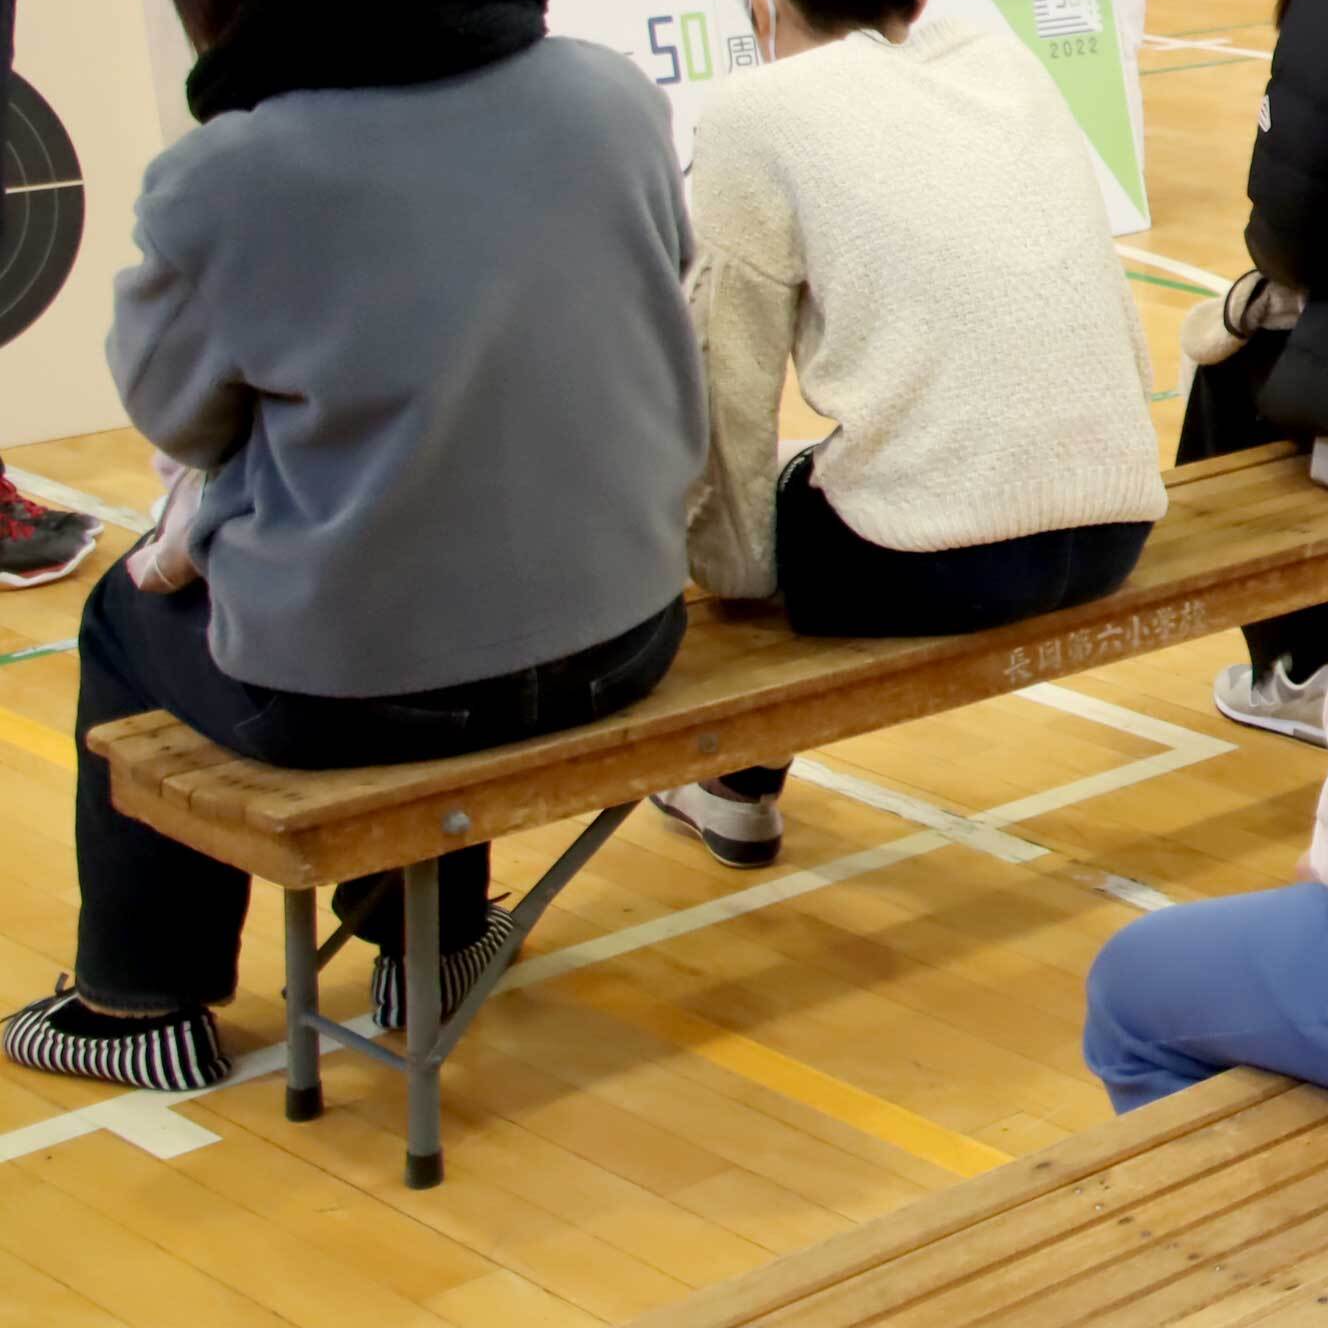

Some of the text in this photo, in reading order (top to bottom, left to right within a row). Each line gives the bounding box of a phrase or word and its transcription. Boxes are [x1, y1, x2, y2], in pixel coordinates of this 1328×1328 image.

[1049, 36, 1098, 59] 2022
[1003, 598, 1208, 684] 長岡第六小学校
